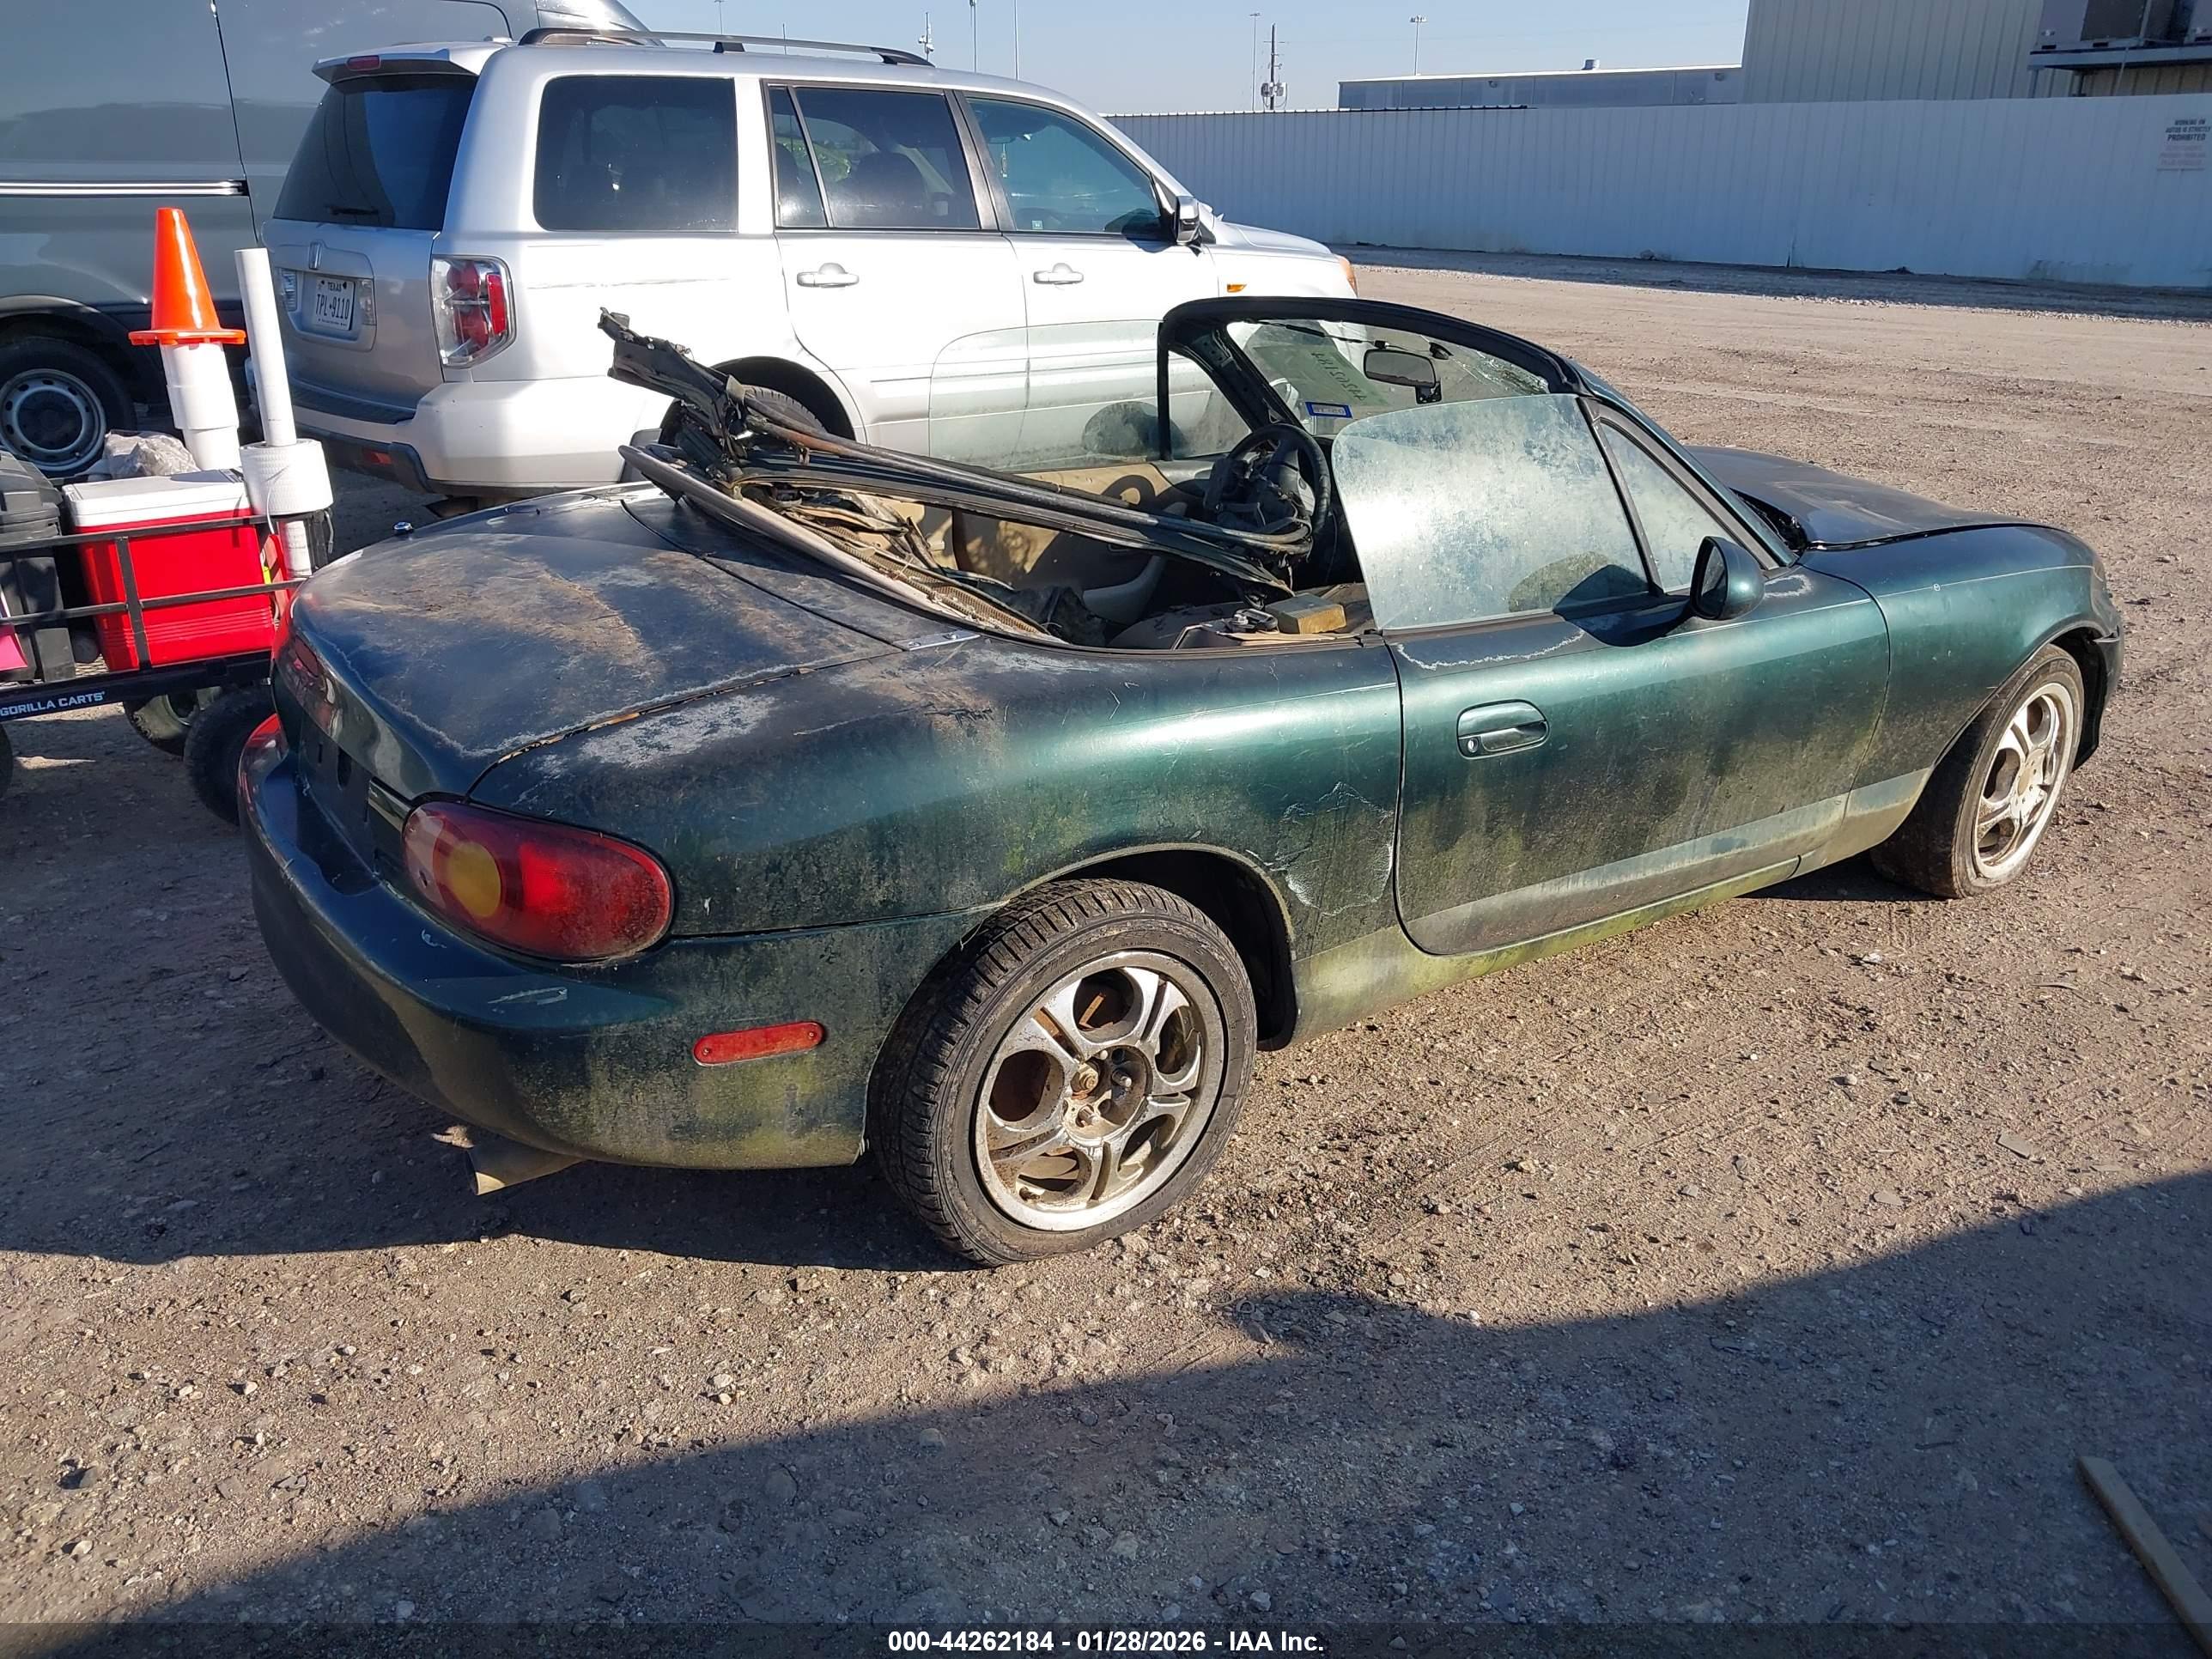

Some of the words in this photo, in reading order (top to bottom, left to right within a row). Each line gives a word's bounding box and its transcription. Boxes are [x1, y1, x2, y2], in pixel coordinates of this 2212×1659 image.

[327, 281, 342, 292] TEXAS
[0, 700, 56, 716] GORILLA
[58, 692, 104, 708] CARTS
